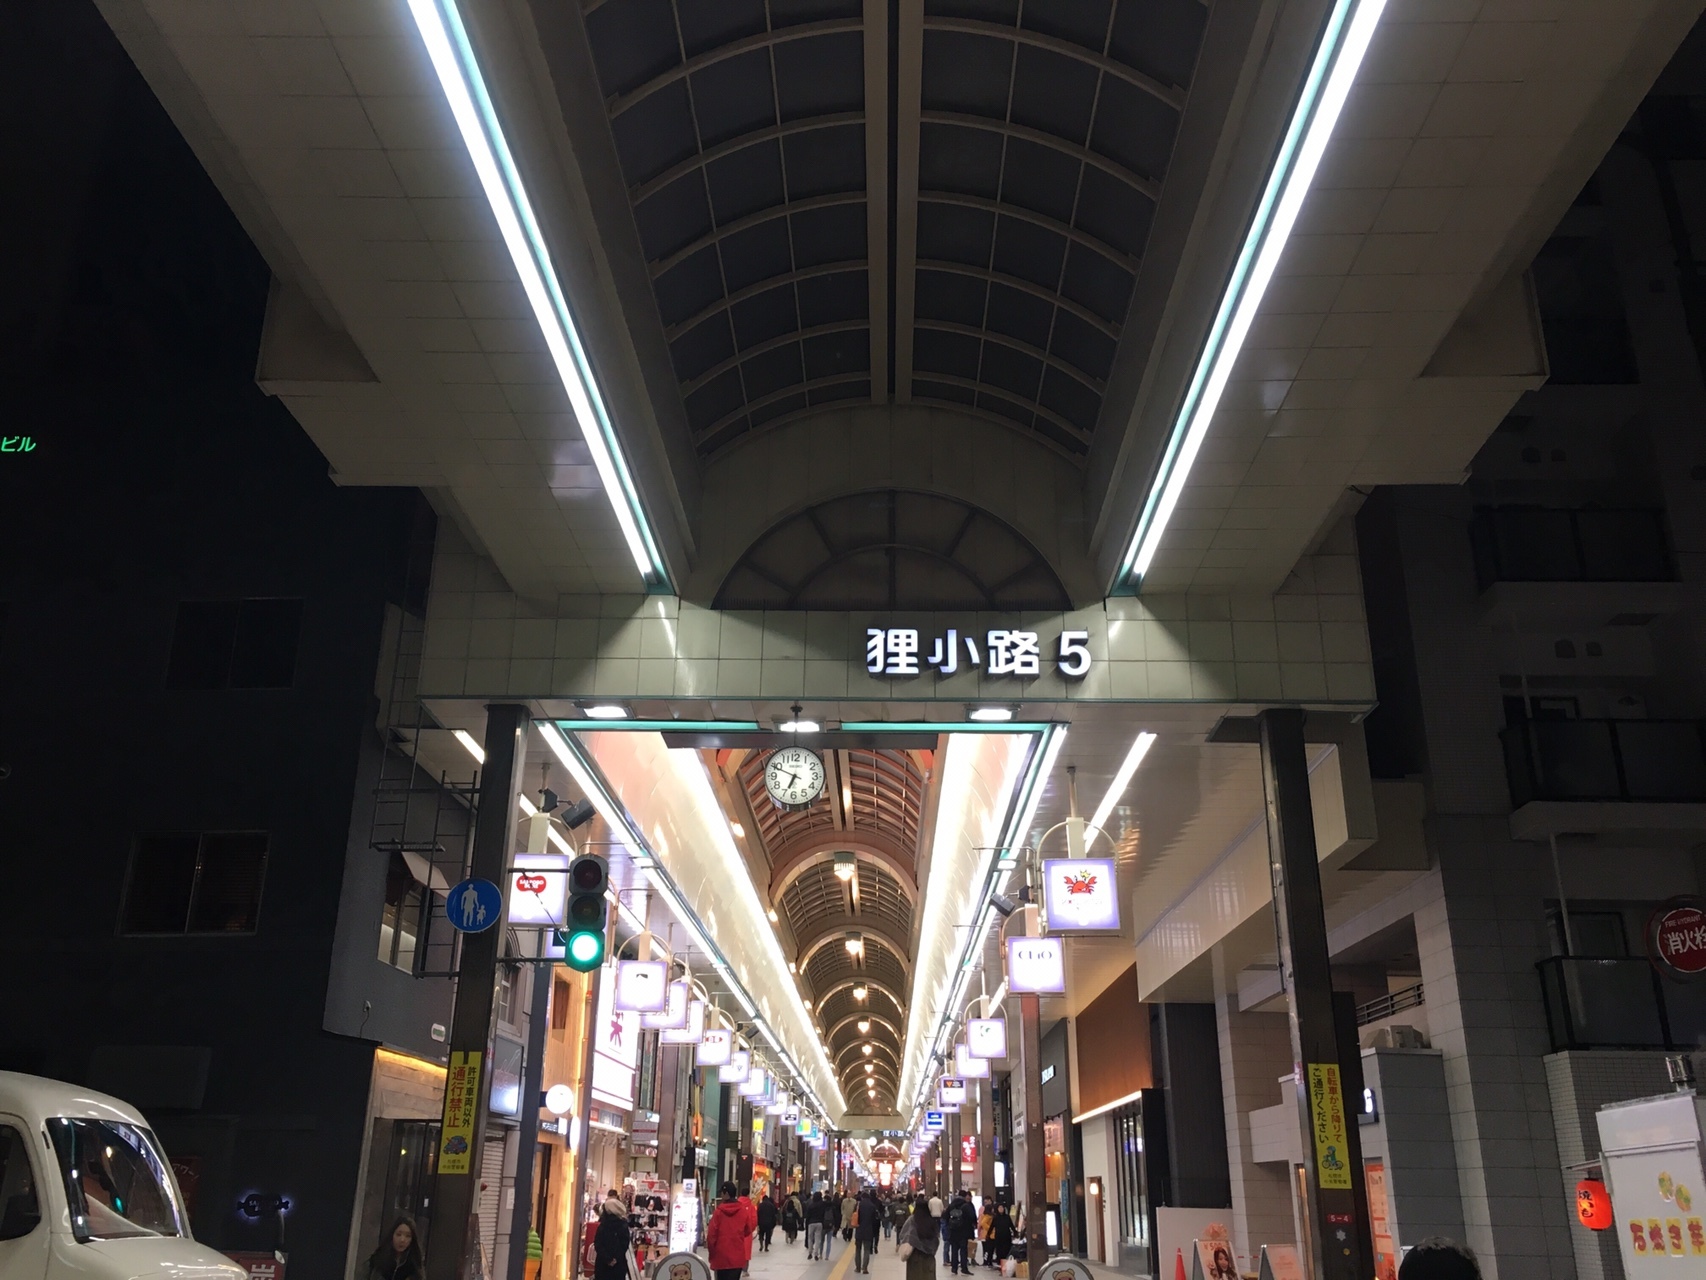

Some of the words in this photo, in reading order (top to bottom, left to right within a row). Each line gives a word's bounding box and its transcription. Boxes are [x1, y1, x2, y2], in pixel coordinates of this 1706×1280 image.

[1, 436, 37, 452] ビル
[866, 628, 1040, 675] 狸小路
[1058, 630, 1092, 676] 5
[791, 753, 800, 762] 12
[809, 762, 817, 771] 2
[770, 772, 778, 781] 9
[812, 772, 819, 781] 3
[773, 781, 781, 790] 8
[808, 781, 816, 790] 4
[781, 788, 788, 797] 7
[790, 791, 797, 800] 6
[801, 788, 808, 797] 5
[446, 1066, 466, 1128] 通行禁止
[462, 1066, 477, 1128] 許可車両以外
[1312, 1067, 1329, 1144] ご通行ください
[1326, 1067, 1342, 1143] 自転車から降りて
[1330, 1214, 1349, 1222] 5-4
